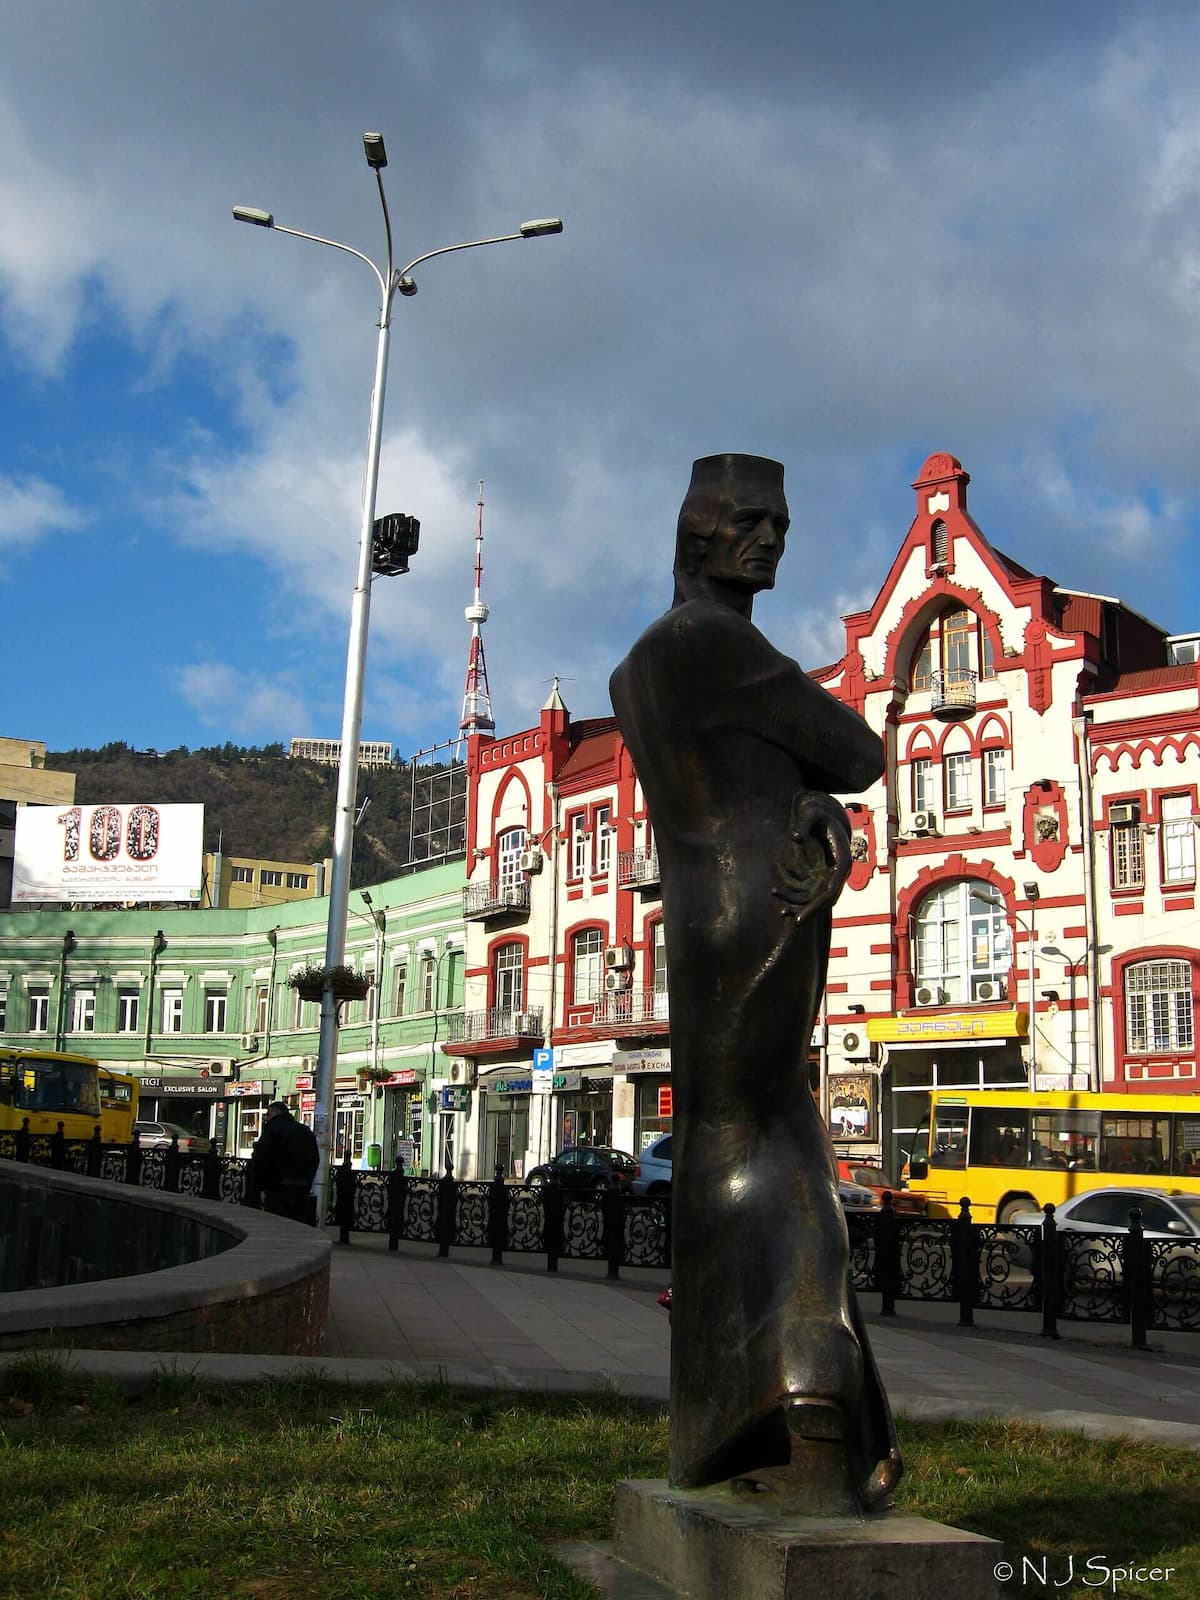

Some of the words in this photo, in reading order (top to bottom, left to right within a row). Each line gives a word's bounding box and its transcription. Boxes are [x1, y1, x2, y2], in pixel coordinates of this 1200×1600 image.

[58, 805, 160, 862] 100
[537, 1052, 550, 1066] P
[647, 1061, 671, 1070] EXCHA
[140, 1077, 161, 1086] TIGI
